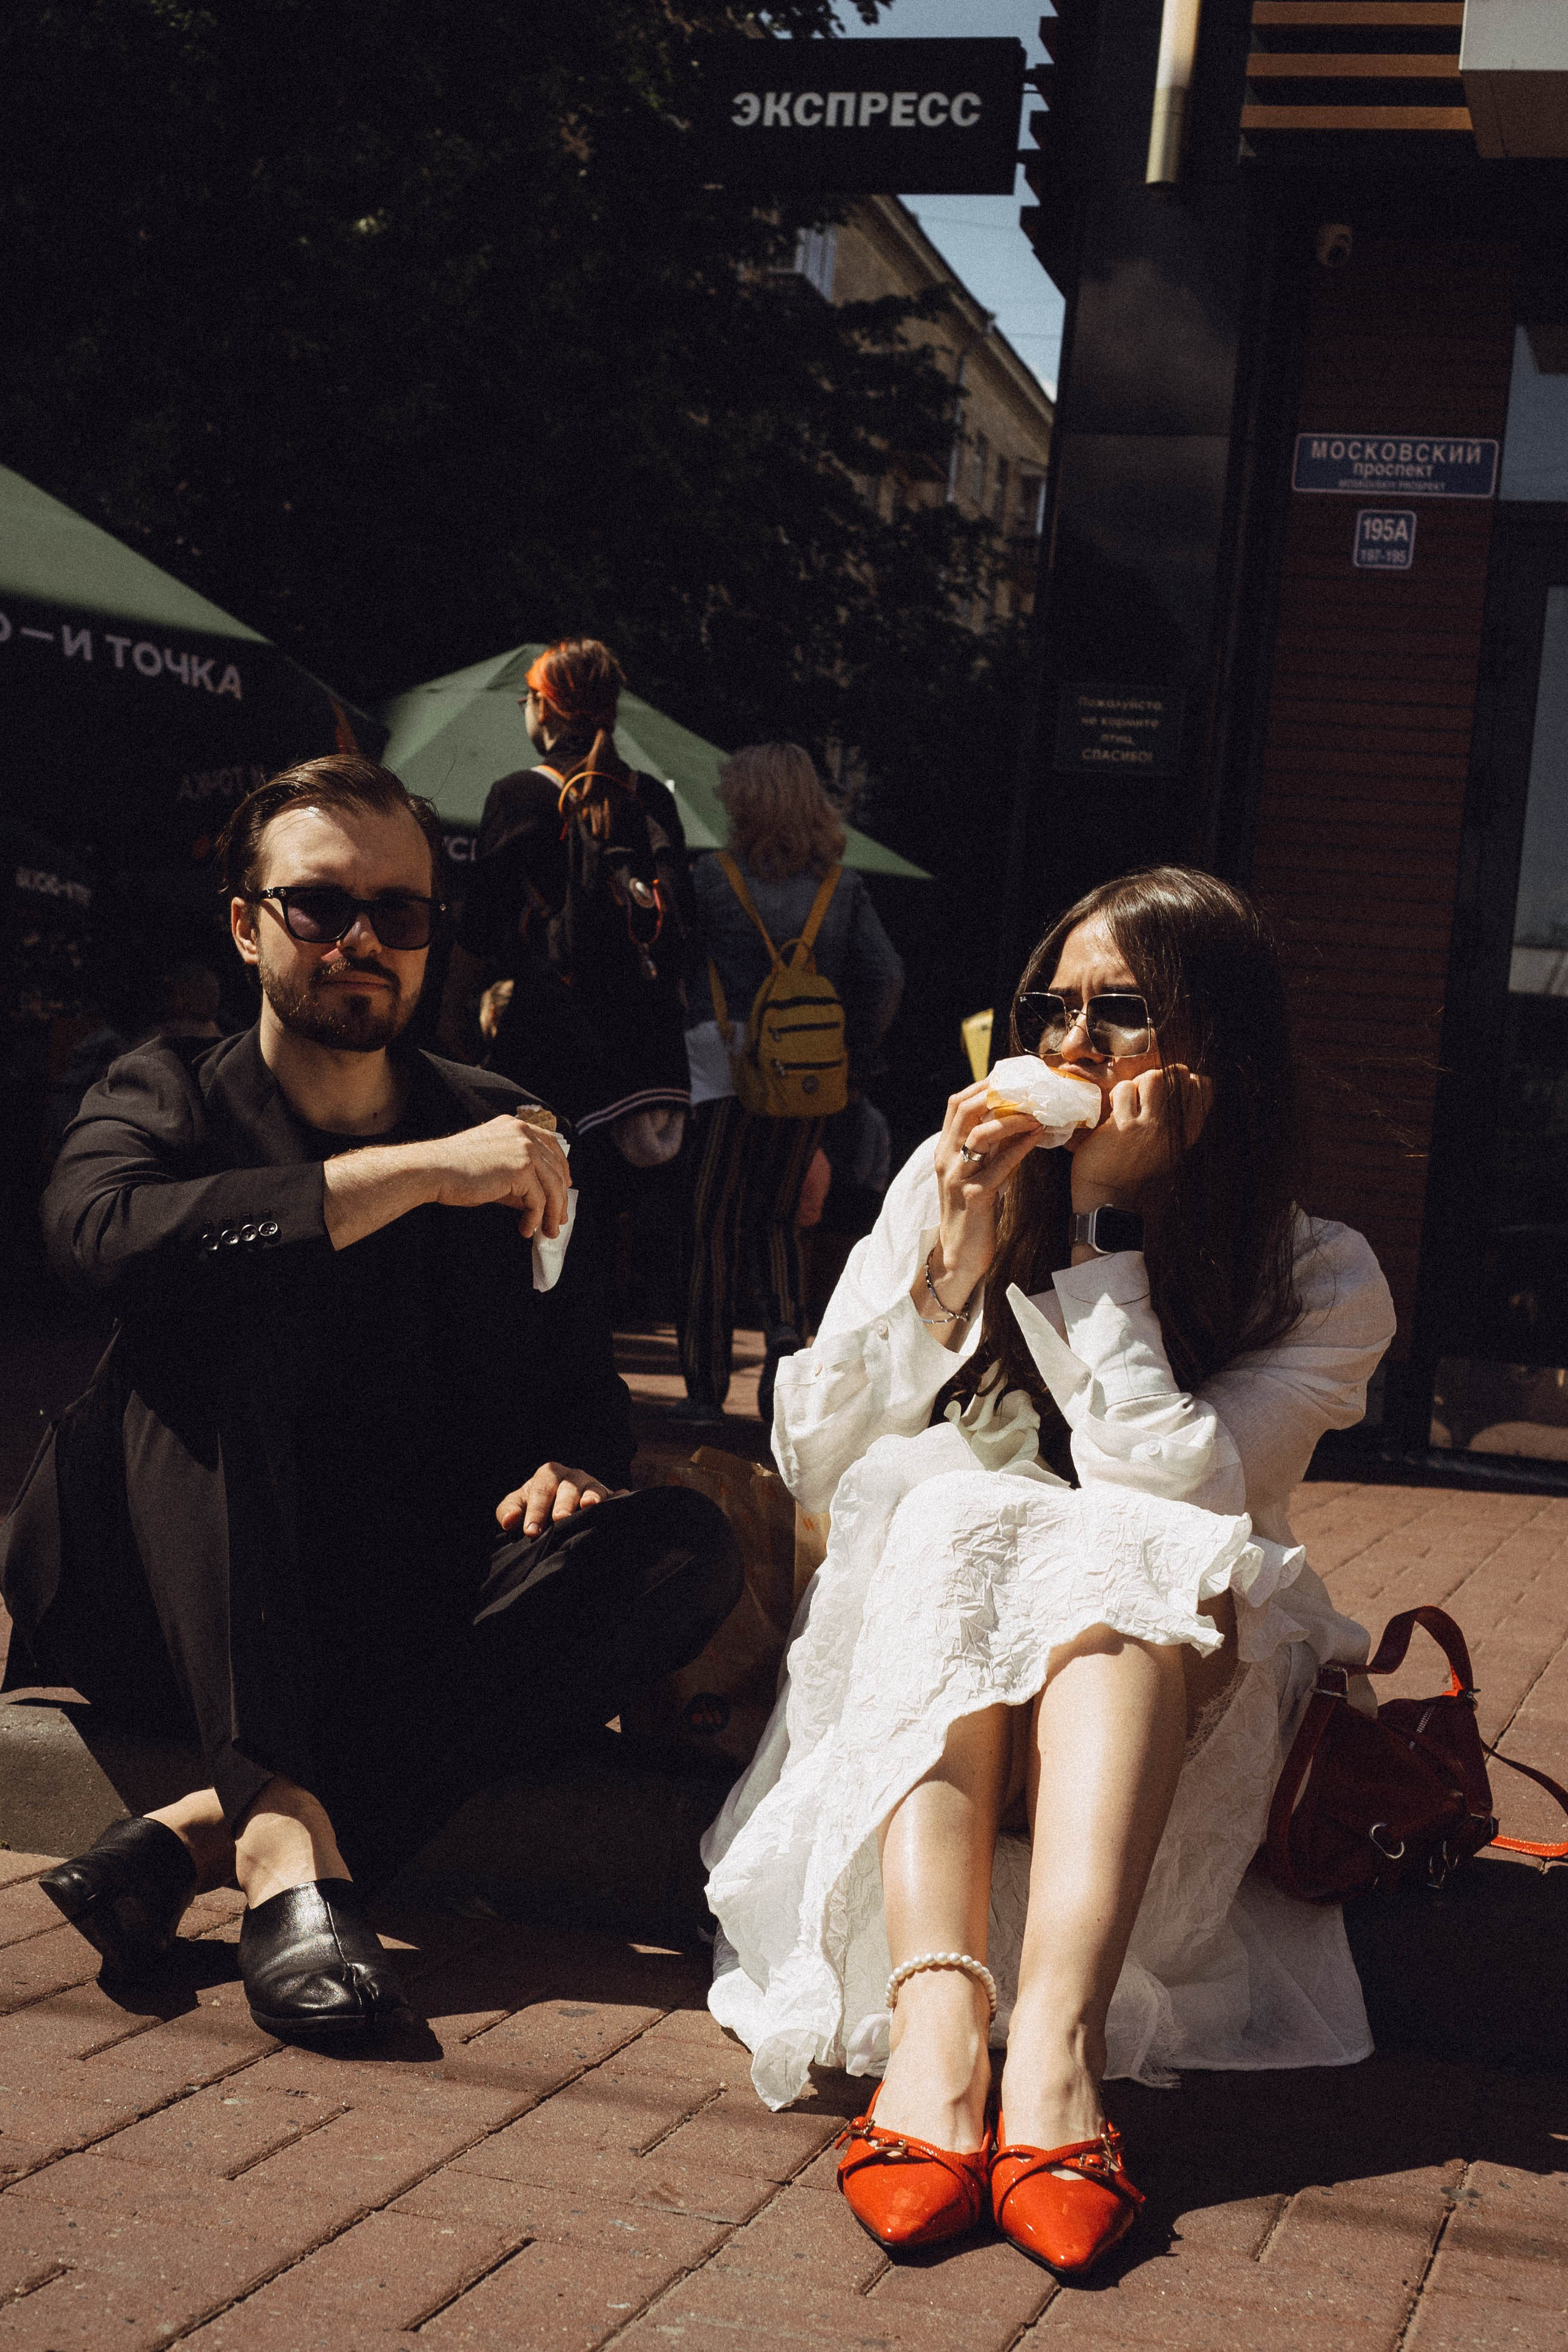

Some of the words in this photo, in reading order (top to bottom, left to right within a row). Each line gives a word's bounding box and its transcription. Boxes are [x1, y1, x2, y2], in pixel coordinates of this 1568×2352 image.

[731, 92, 982, 127] ЭКСПРЕСС
[1311, 439, 1481, 464] МОСКОВСКИЙ
[1353, 462, 1434, 478] проспект
[1363, 518, 1408, 541] 195А
[105, 634, 243, 700] ТОЧКА
